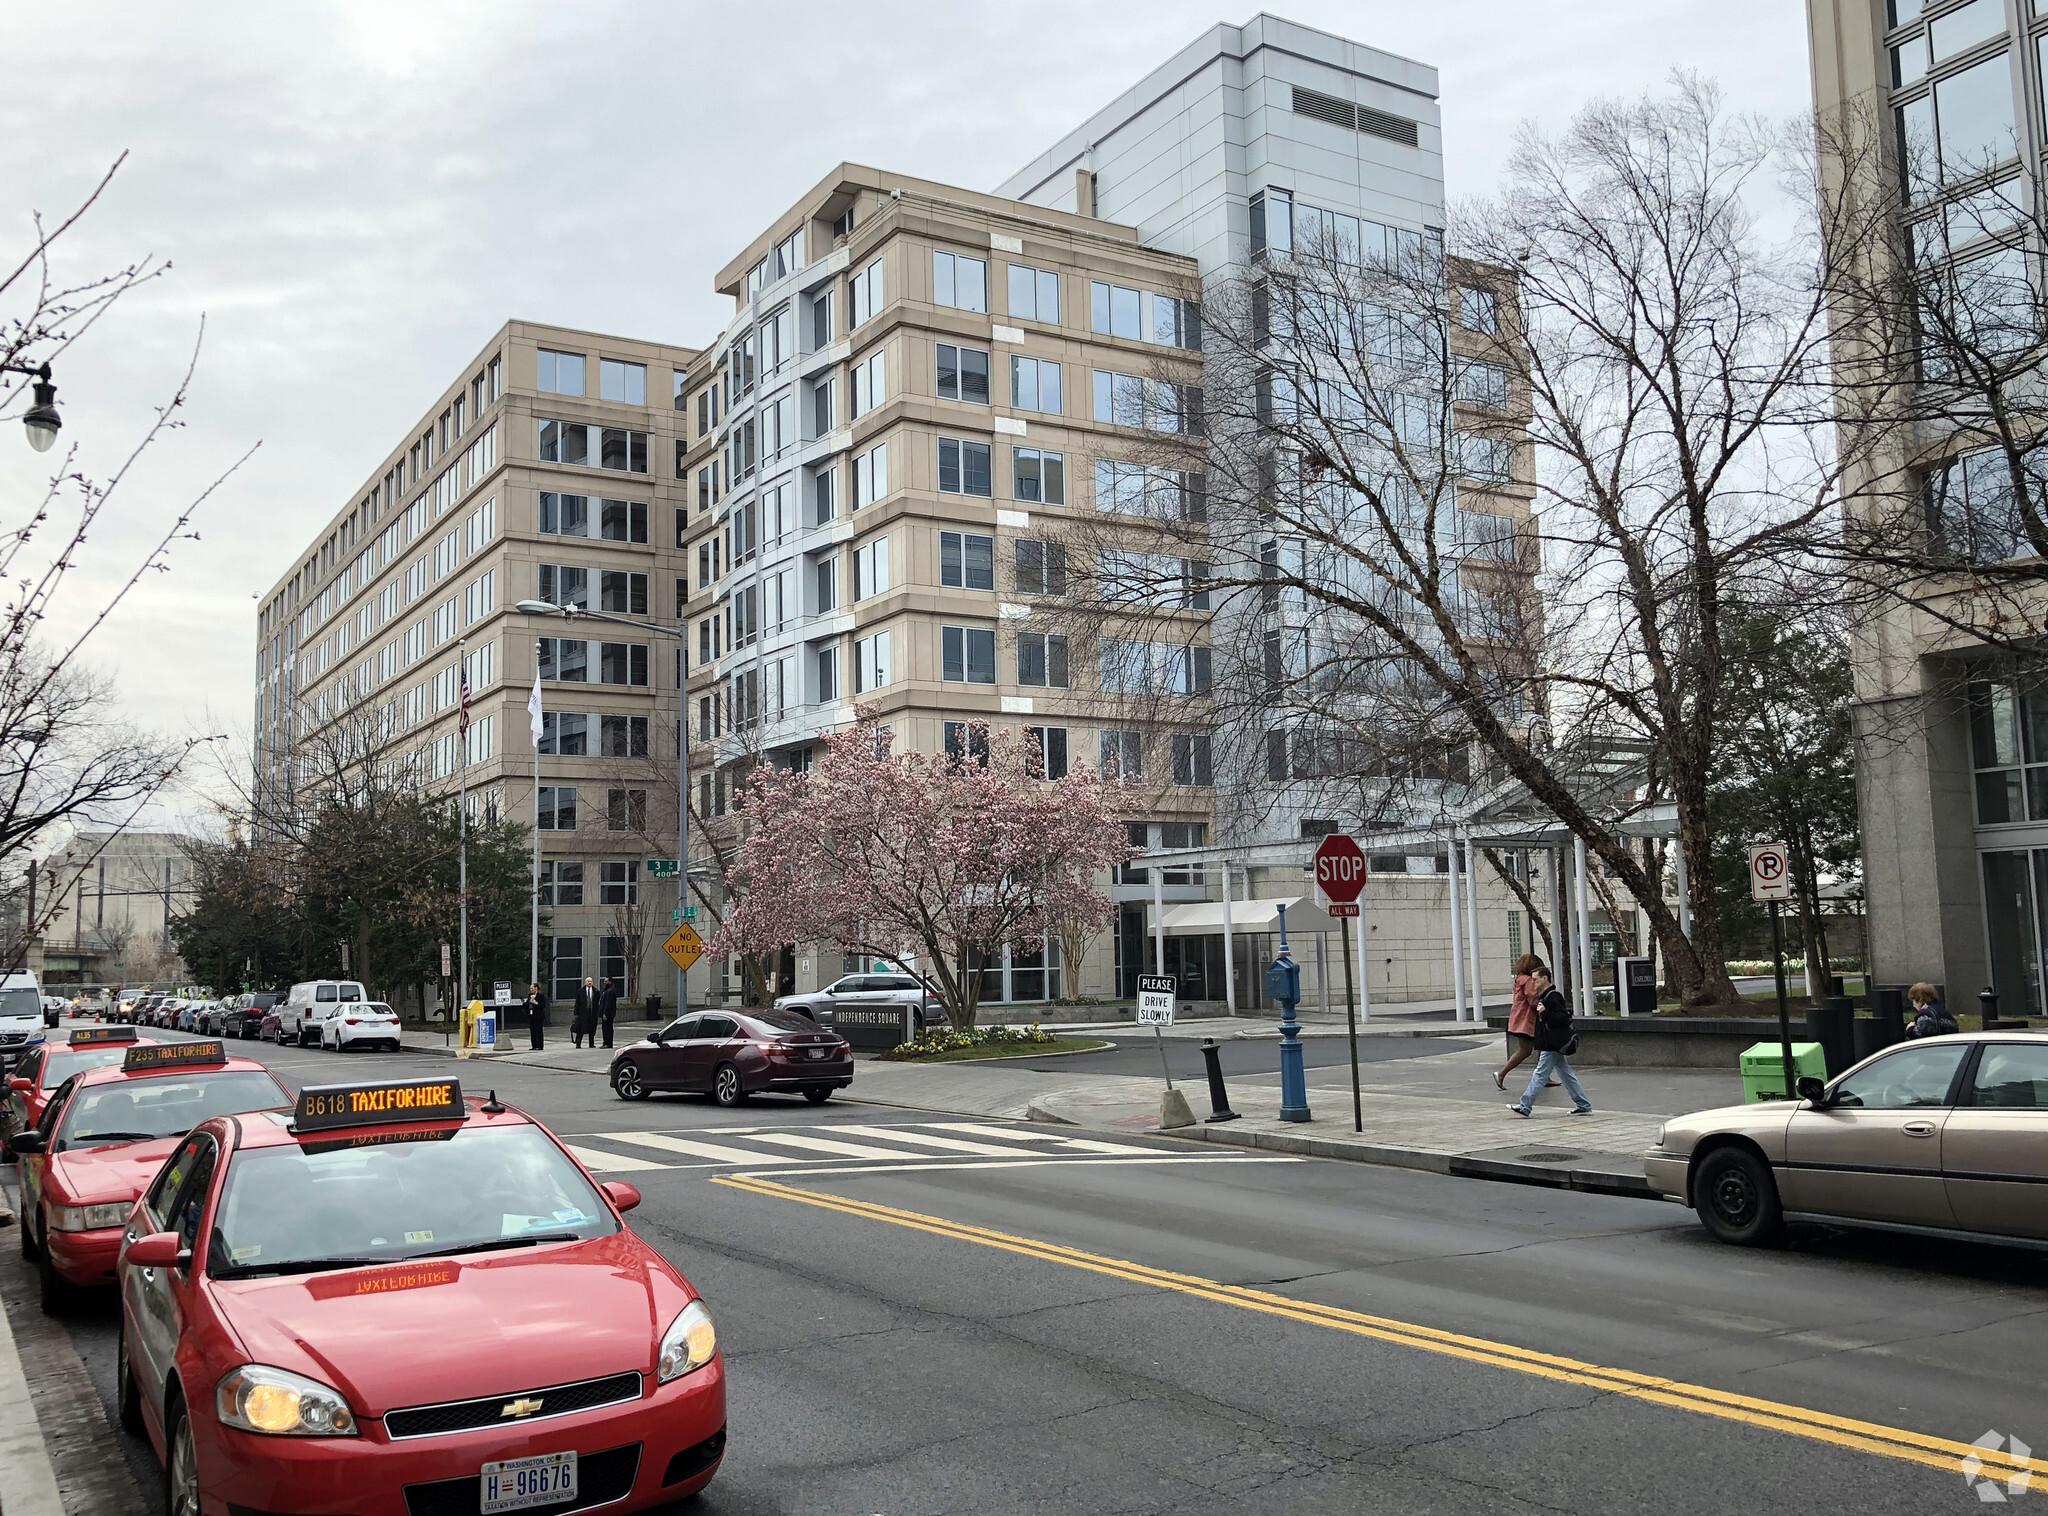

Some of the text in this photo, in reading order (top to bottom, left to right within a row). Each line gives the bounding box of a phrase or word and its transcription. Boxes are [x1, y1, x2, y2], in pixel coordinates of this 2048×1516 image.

[1319, 856, 1362, 881] STOP
[1331, 906, 1357, 915] ALL WAY
[668, 945, 701, 954] OUTLET
[1142, 978, 1172, 990] PLEASE
[1145, 996, 1168, 1007] DRIVE
[836, 1012, 900, 1024] INDEPENDENCE SQUARE
[1140, 1009, 1170, 1021] SLOWLY
[129, 1049, 153, 1062] F235
[306, 1094, 345, 1116] B618
[488, 1464, 570, 1500] H 96676
[484, 1491, 574, 1511] TAXATION WITHOUT REPRESENTATION
